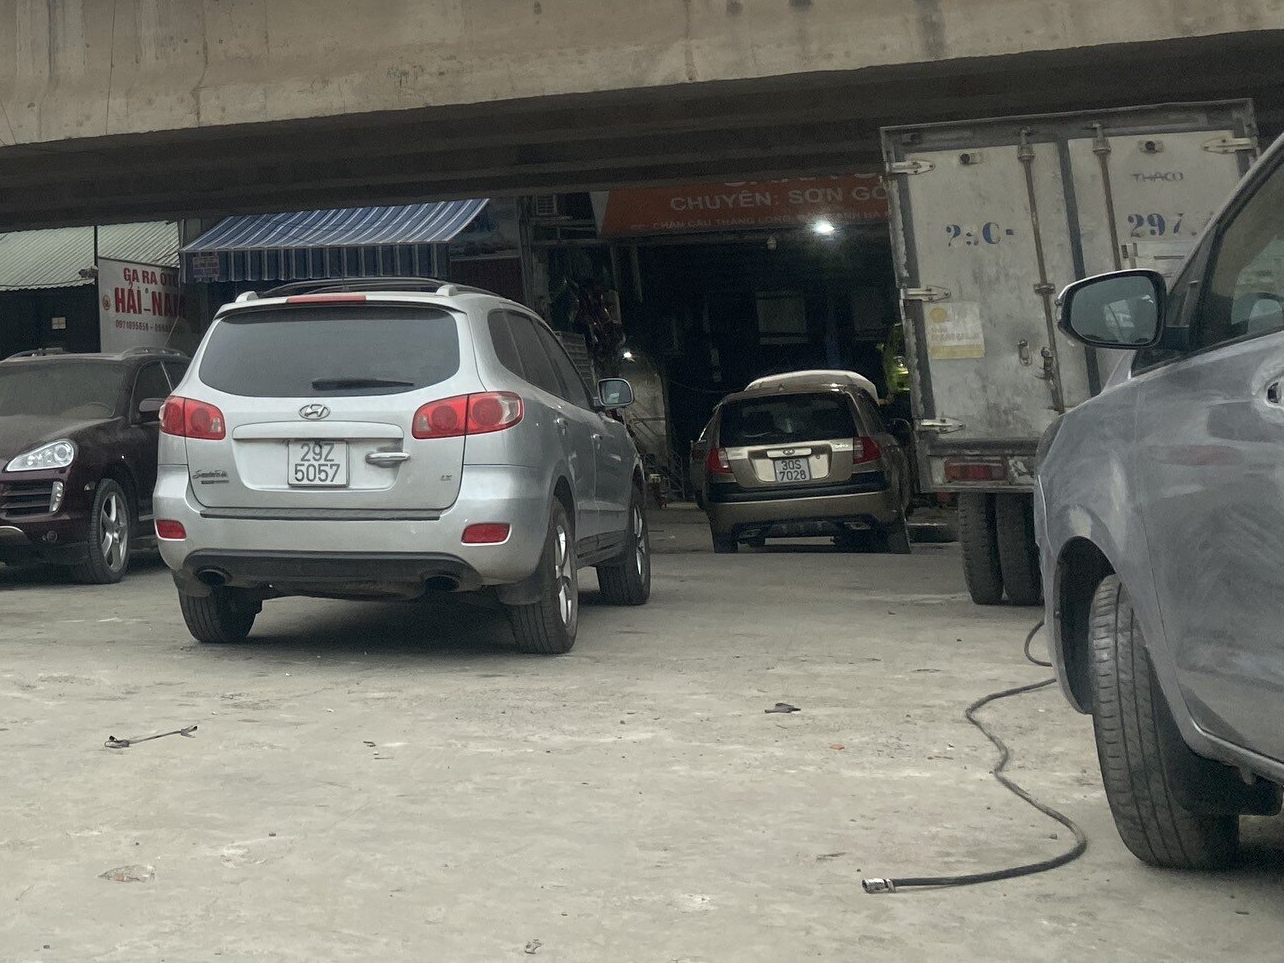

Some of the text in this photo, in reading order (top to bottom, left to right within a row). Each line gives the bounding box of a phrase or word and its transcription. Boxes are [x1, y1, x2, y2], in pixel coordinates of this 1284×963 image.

[141, 269, 158, 286] RA
[300, 442, 335, 463] 29Z
[294, 463, 341, 483] 5057
[780, 459, 803, 471] 30S
[779, 469, 808, 482] 7028
